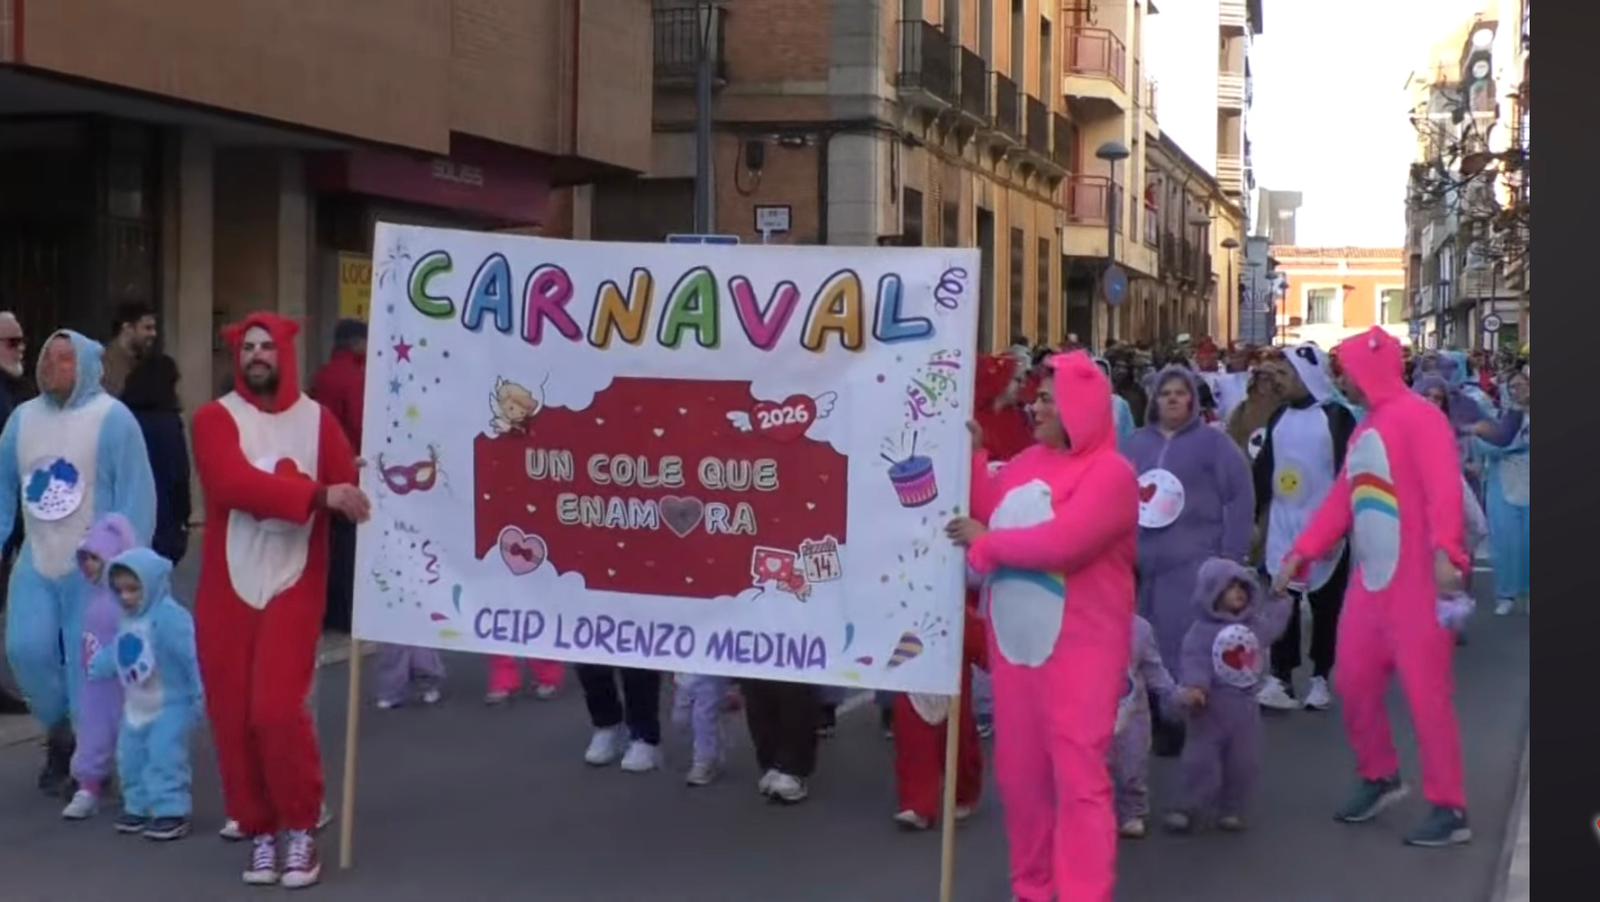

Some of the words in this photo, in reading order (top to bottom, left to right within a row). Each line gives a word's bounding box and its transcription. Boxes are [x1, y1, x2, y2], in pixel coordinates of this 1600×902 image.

[407, 250, 936, 351] CARNAVAL
[757, 404, 809, 430] 2026
[525, 448, 574, 482] UN
[587, 453, 685, 488] COLE
[699, 457, 778, 491] QUE
[556, 494, 757, 537] ENAMRA
[813, 554, 831, 578] 14
[474, 607, 545, 645] CEIP
[554, 613, 695, 658] LORENZO
[706, 629, 827, 669] MEDINA
